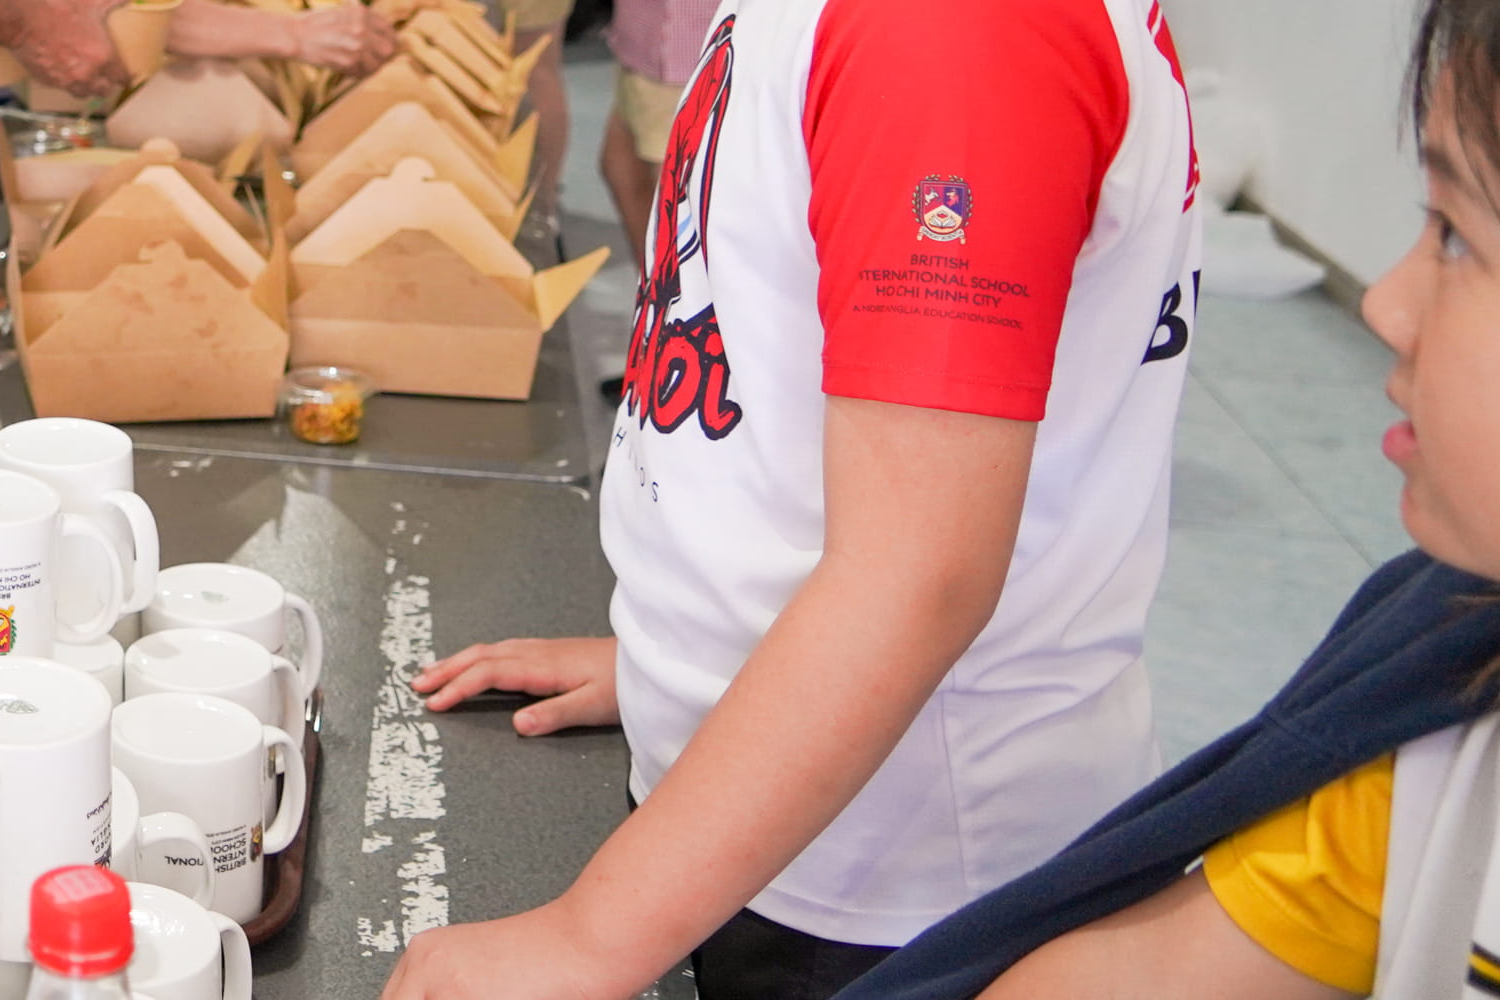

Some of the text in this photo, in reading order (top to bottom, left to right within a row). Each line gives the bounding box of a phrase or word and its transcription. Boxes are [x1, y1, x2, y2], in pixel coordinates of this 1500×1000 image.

[910, 254, 969, 271] BRITISH
[971, 276, 1029, 297] SCHOOL
[924, 287, 969, 304] MINH
[972, 293, 1001, 308] CITY
[923, 307, 985, 322] EDUCATION
[4, 575, 18, 583] CHI
[19, 573, 31, 581] HO
